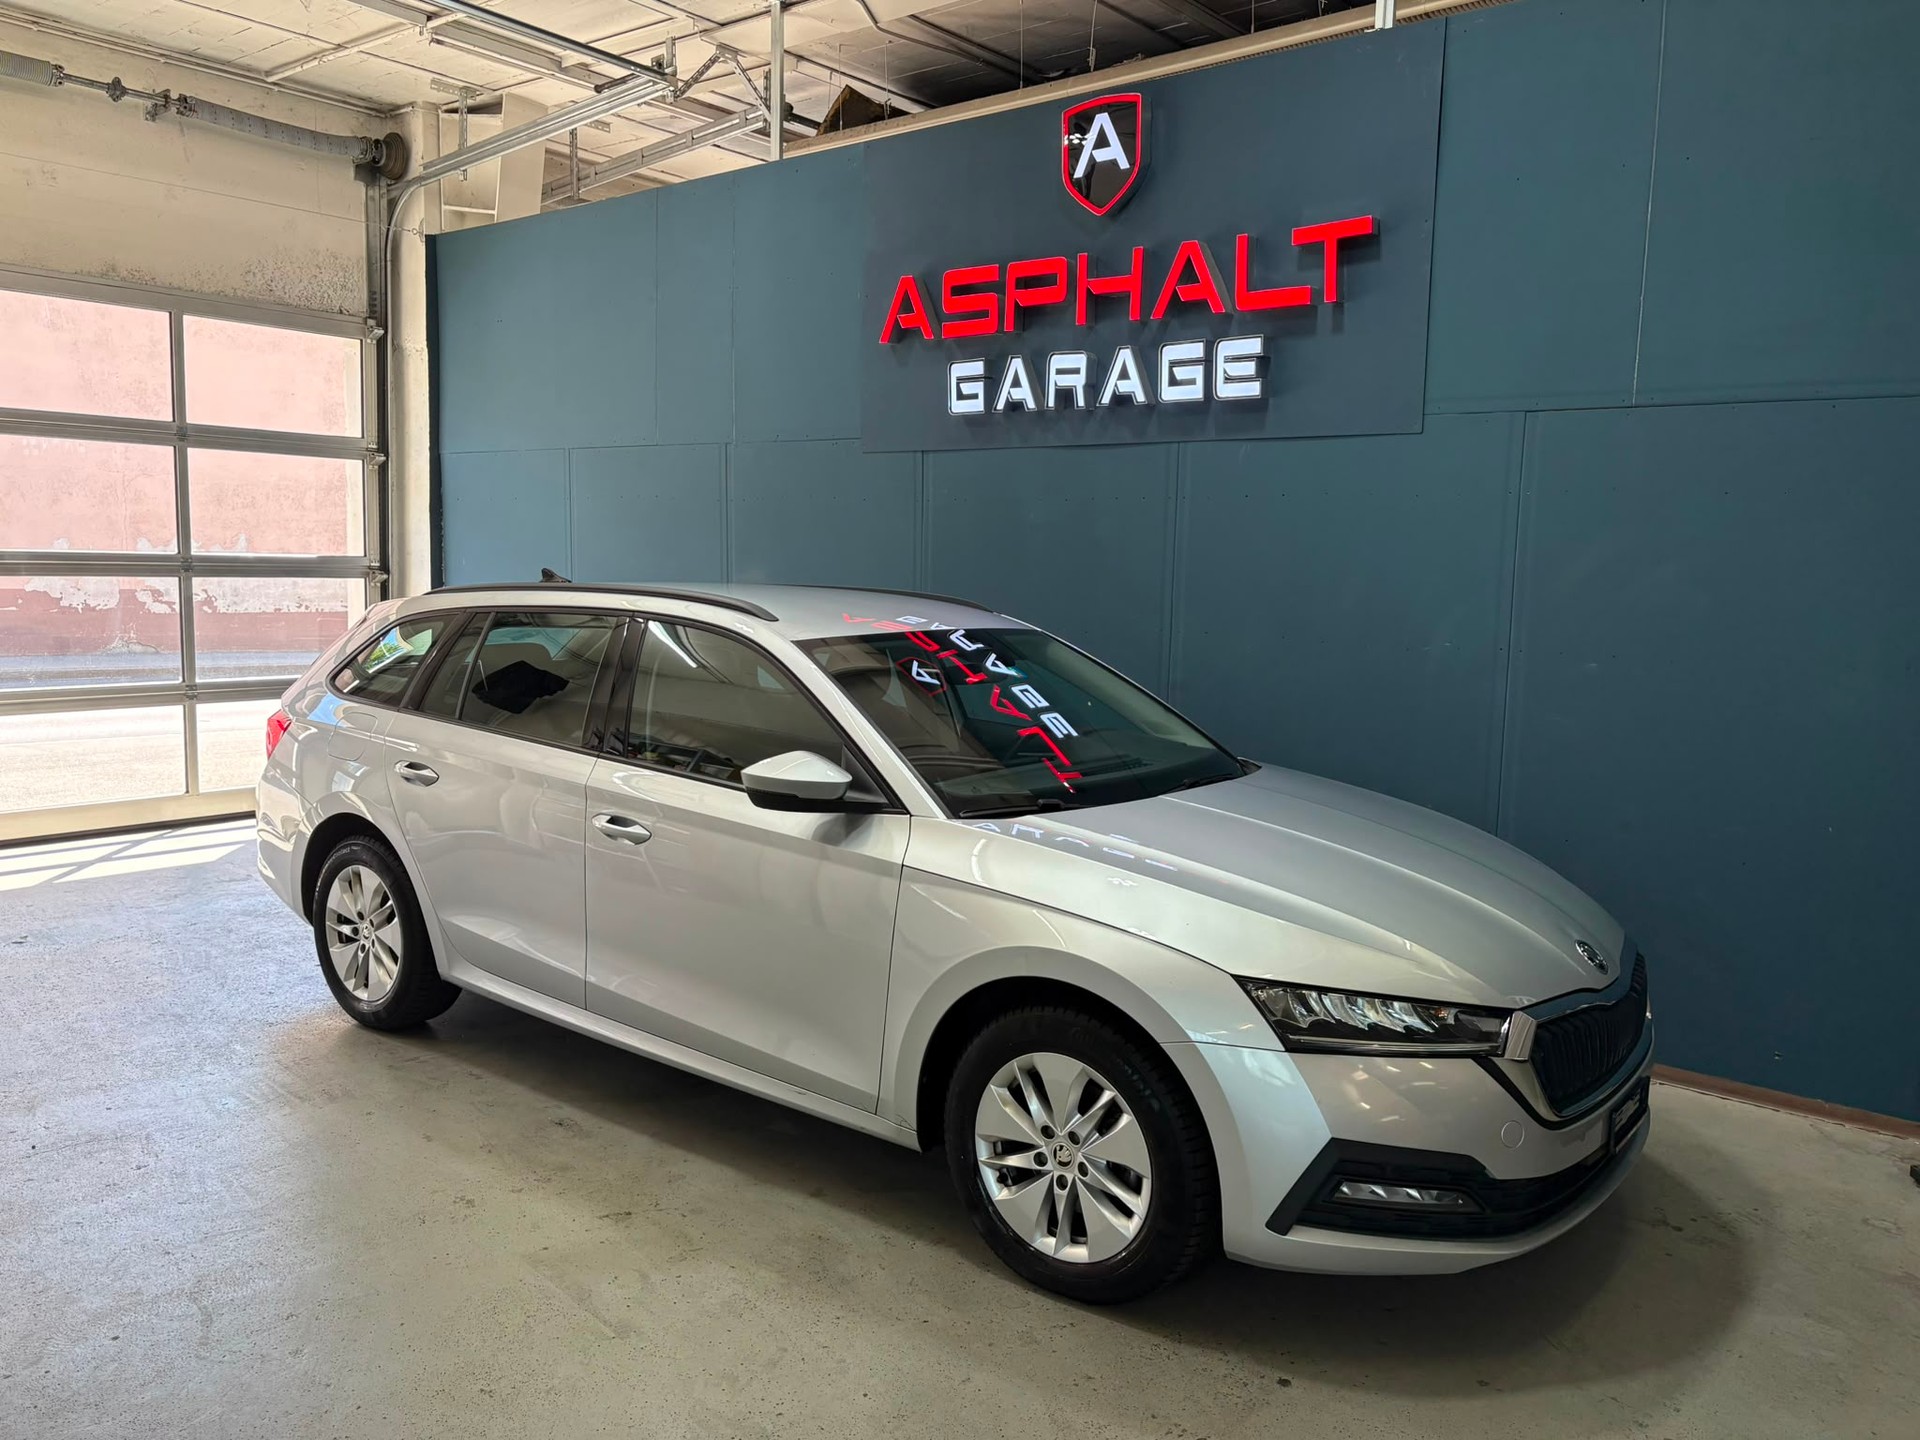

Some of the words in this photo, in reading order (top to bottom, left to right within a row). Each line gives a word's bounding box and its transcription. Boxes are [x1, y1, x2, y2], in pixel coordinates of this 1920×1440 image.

[1072, 112, 1130, 179] A
[879, 215, 1374, 344] ASPHALT
[947, 335, 1264, 415] GARAGE
